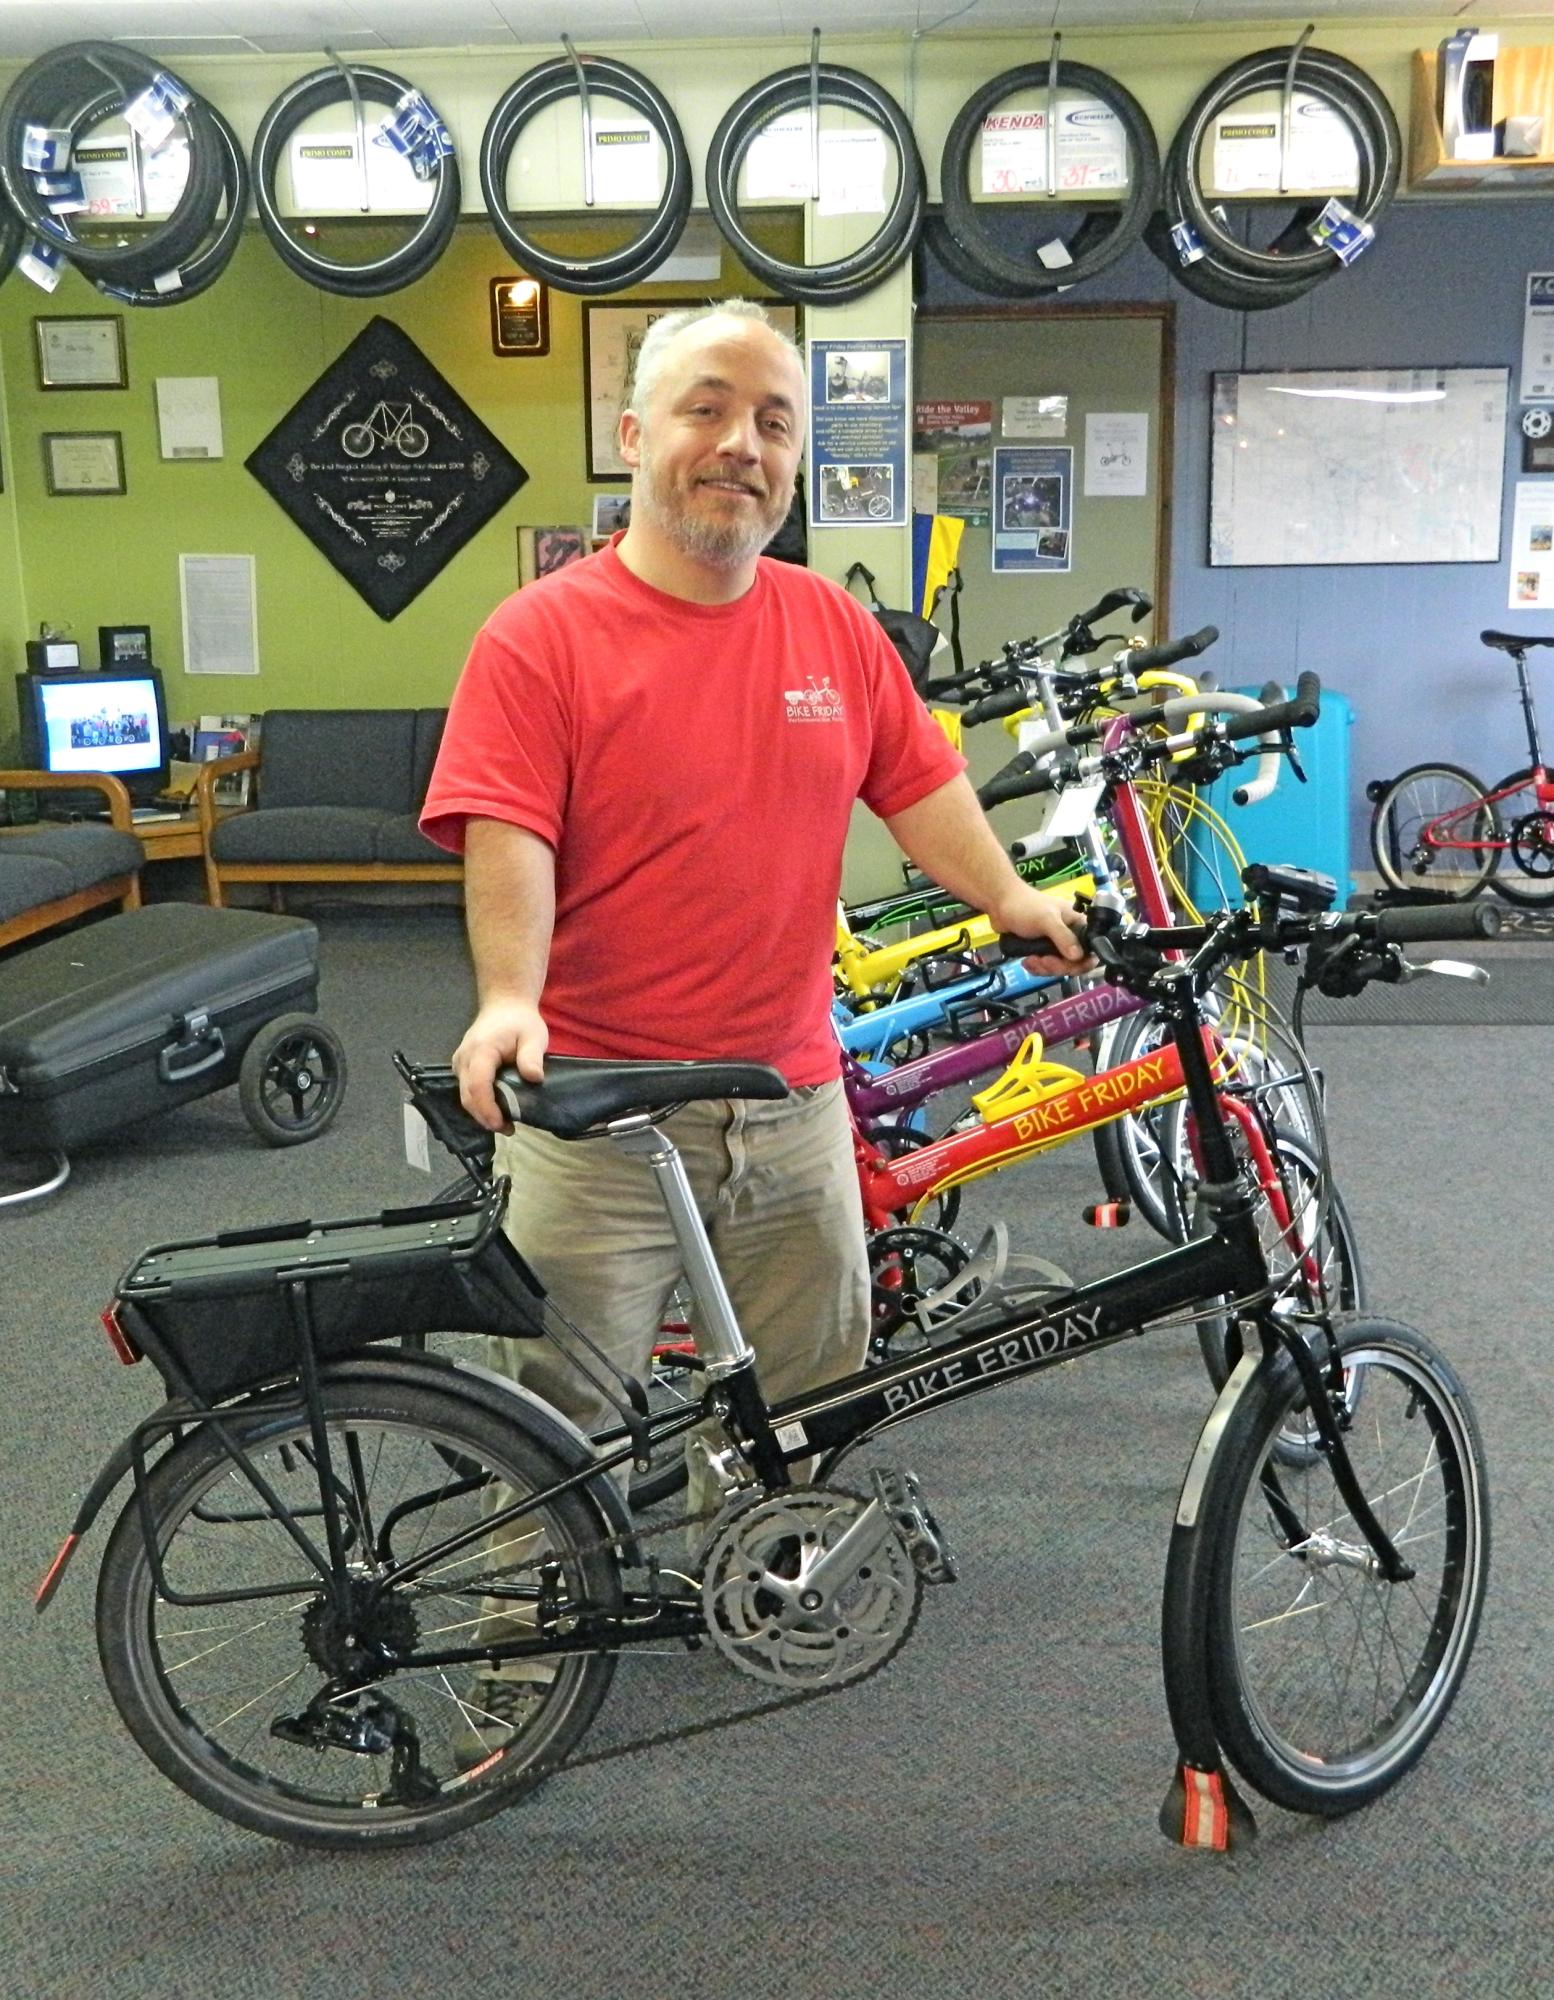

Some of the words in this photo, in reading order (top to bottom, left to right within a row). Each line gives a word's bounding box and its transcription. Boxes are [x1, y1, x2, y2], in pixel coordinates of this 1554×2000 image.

[985, 115, 1044, 130] KENDA
[915, 404, 935, 414] Ride
[937, 404, 952, 414] the
[953, 404, 980, 416] Valley
[786, 706, 811, 717] BIKE
[812, 705, 844, 717] FRIDAY
[1015, 857, 1046, 877] DAY
[1061, 987, 1140, 1030] FRIDA
[1013, 1098, 1076, 1140] BIKE
[1077, 1056, 1166, 1113] FRIDAY
[883, 1361, 964, 1414] BIKE
[976, 1306, 1101, 1375] FRIDAY
